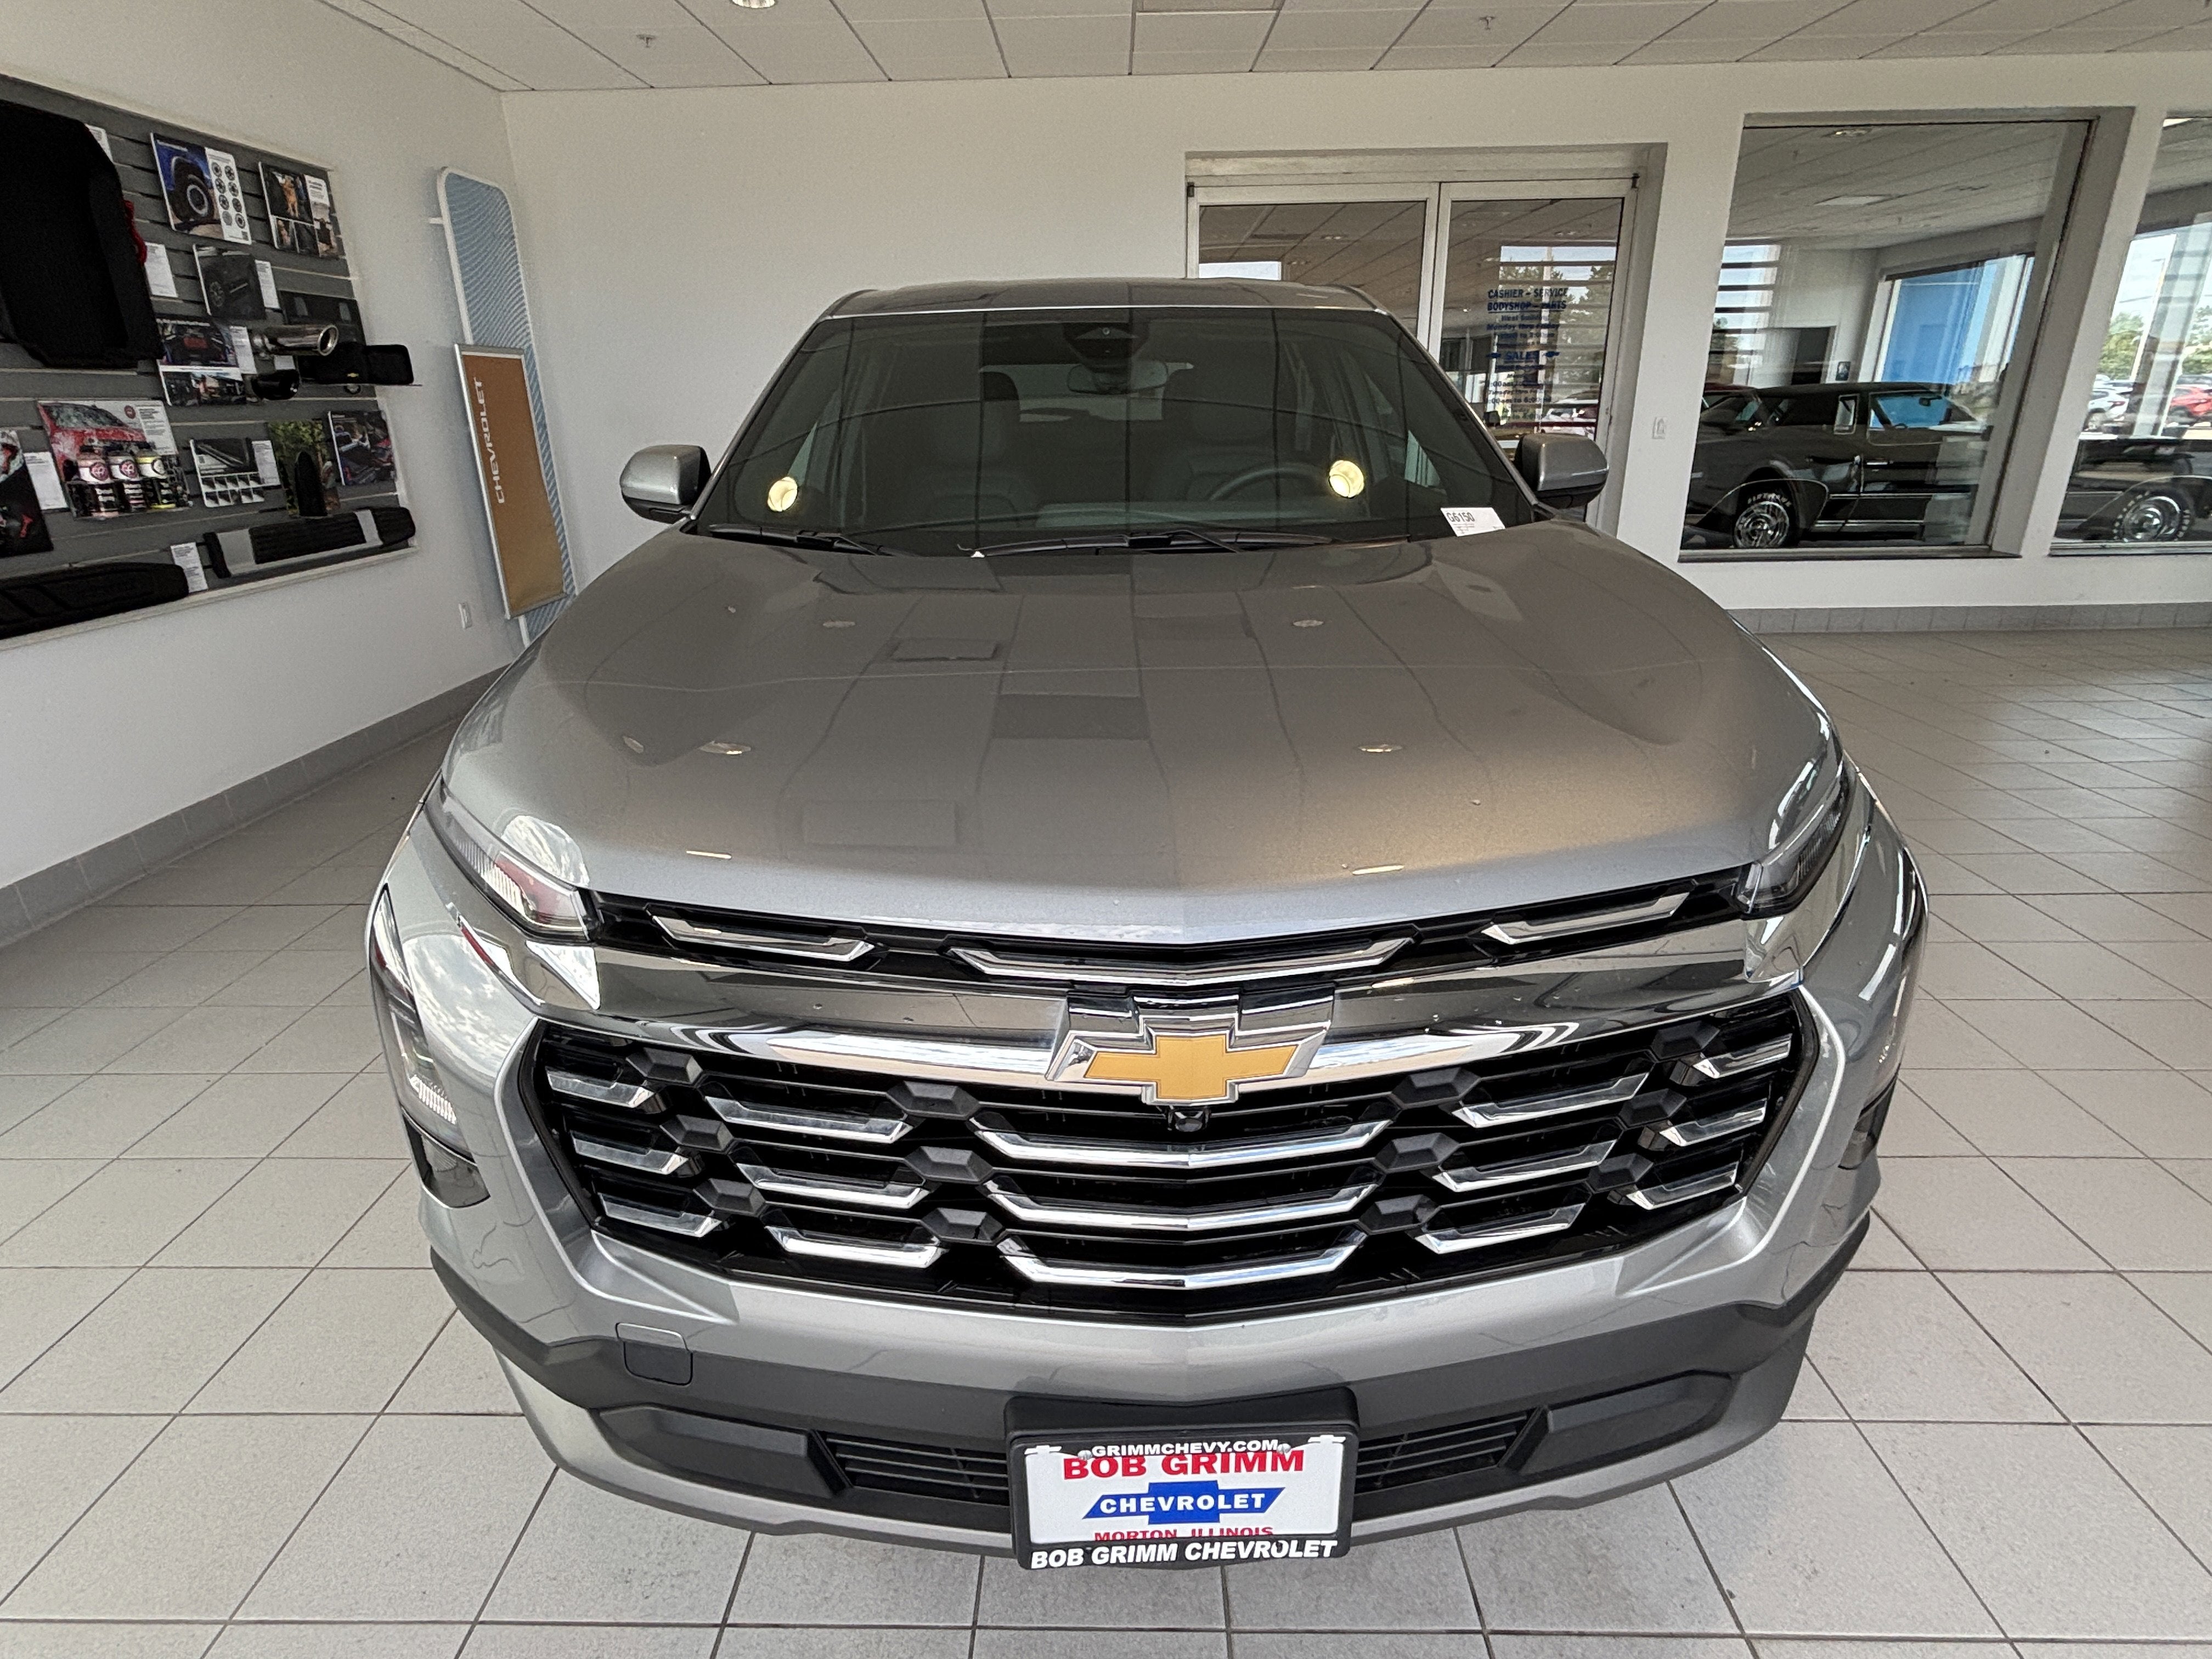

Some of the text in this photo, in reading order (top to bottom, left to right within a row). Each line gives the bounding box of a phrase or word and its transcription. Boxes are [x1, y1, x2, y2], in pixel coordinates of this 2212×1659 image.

[1488, 289, 1523, 299] CASHIER
[1534, 287, 1568, 297] SERVICE
[1487, 302, 1531, 311] BODYSHOP
[1541, 301, 1567, 310] PARTS
[1506, 351, 1538, 360] SALES
[474, 376, 505, 504] CHEVROLET
[1446, 512, 1476, 522] G6150
[1092, 1439, 1279, 1457] GRIMMCHEVY.COM
[1064, 1450, 1305, 1480] BOB GRIMM
[1100, 1493, 1265, 1514] CHEVROLET
[1094, 1529, 1177, 1542] MORTON
[1031, 1539, 1338, 1569] BOB GRIMM CHEVROLET
